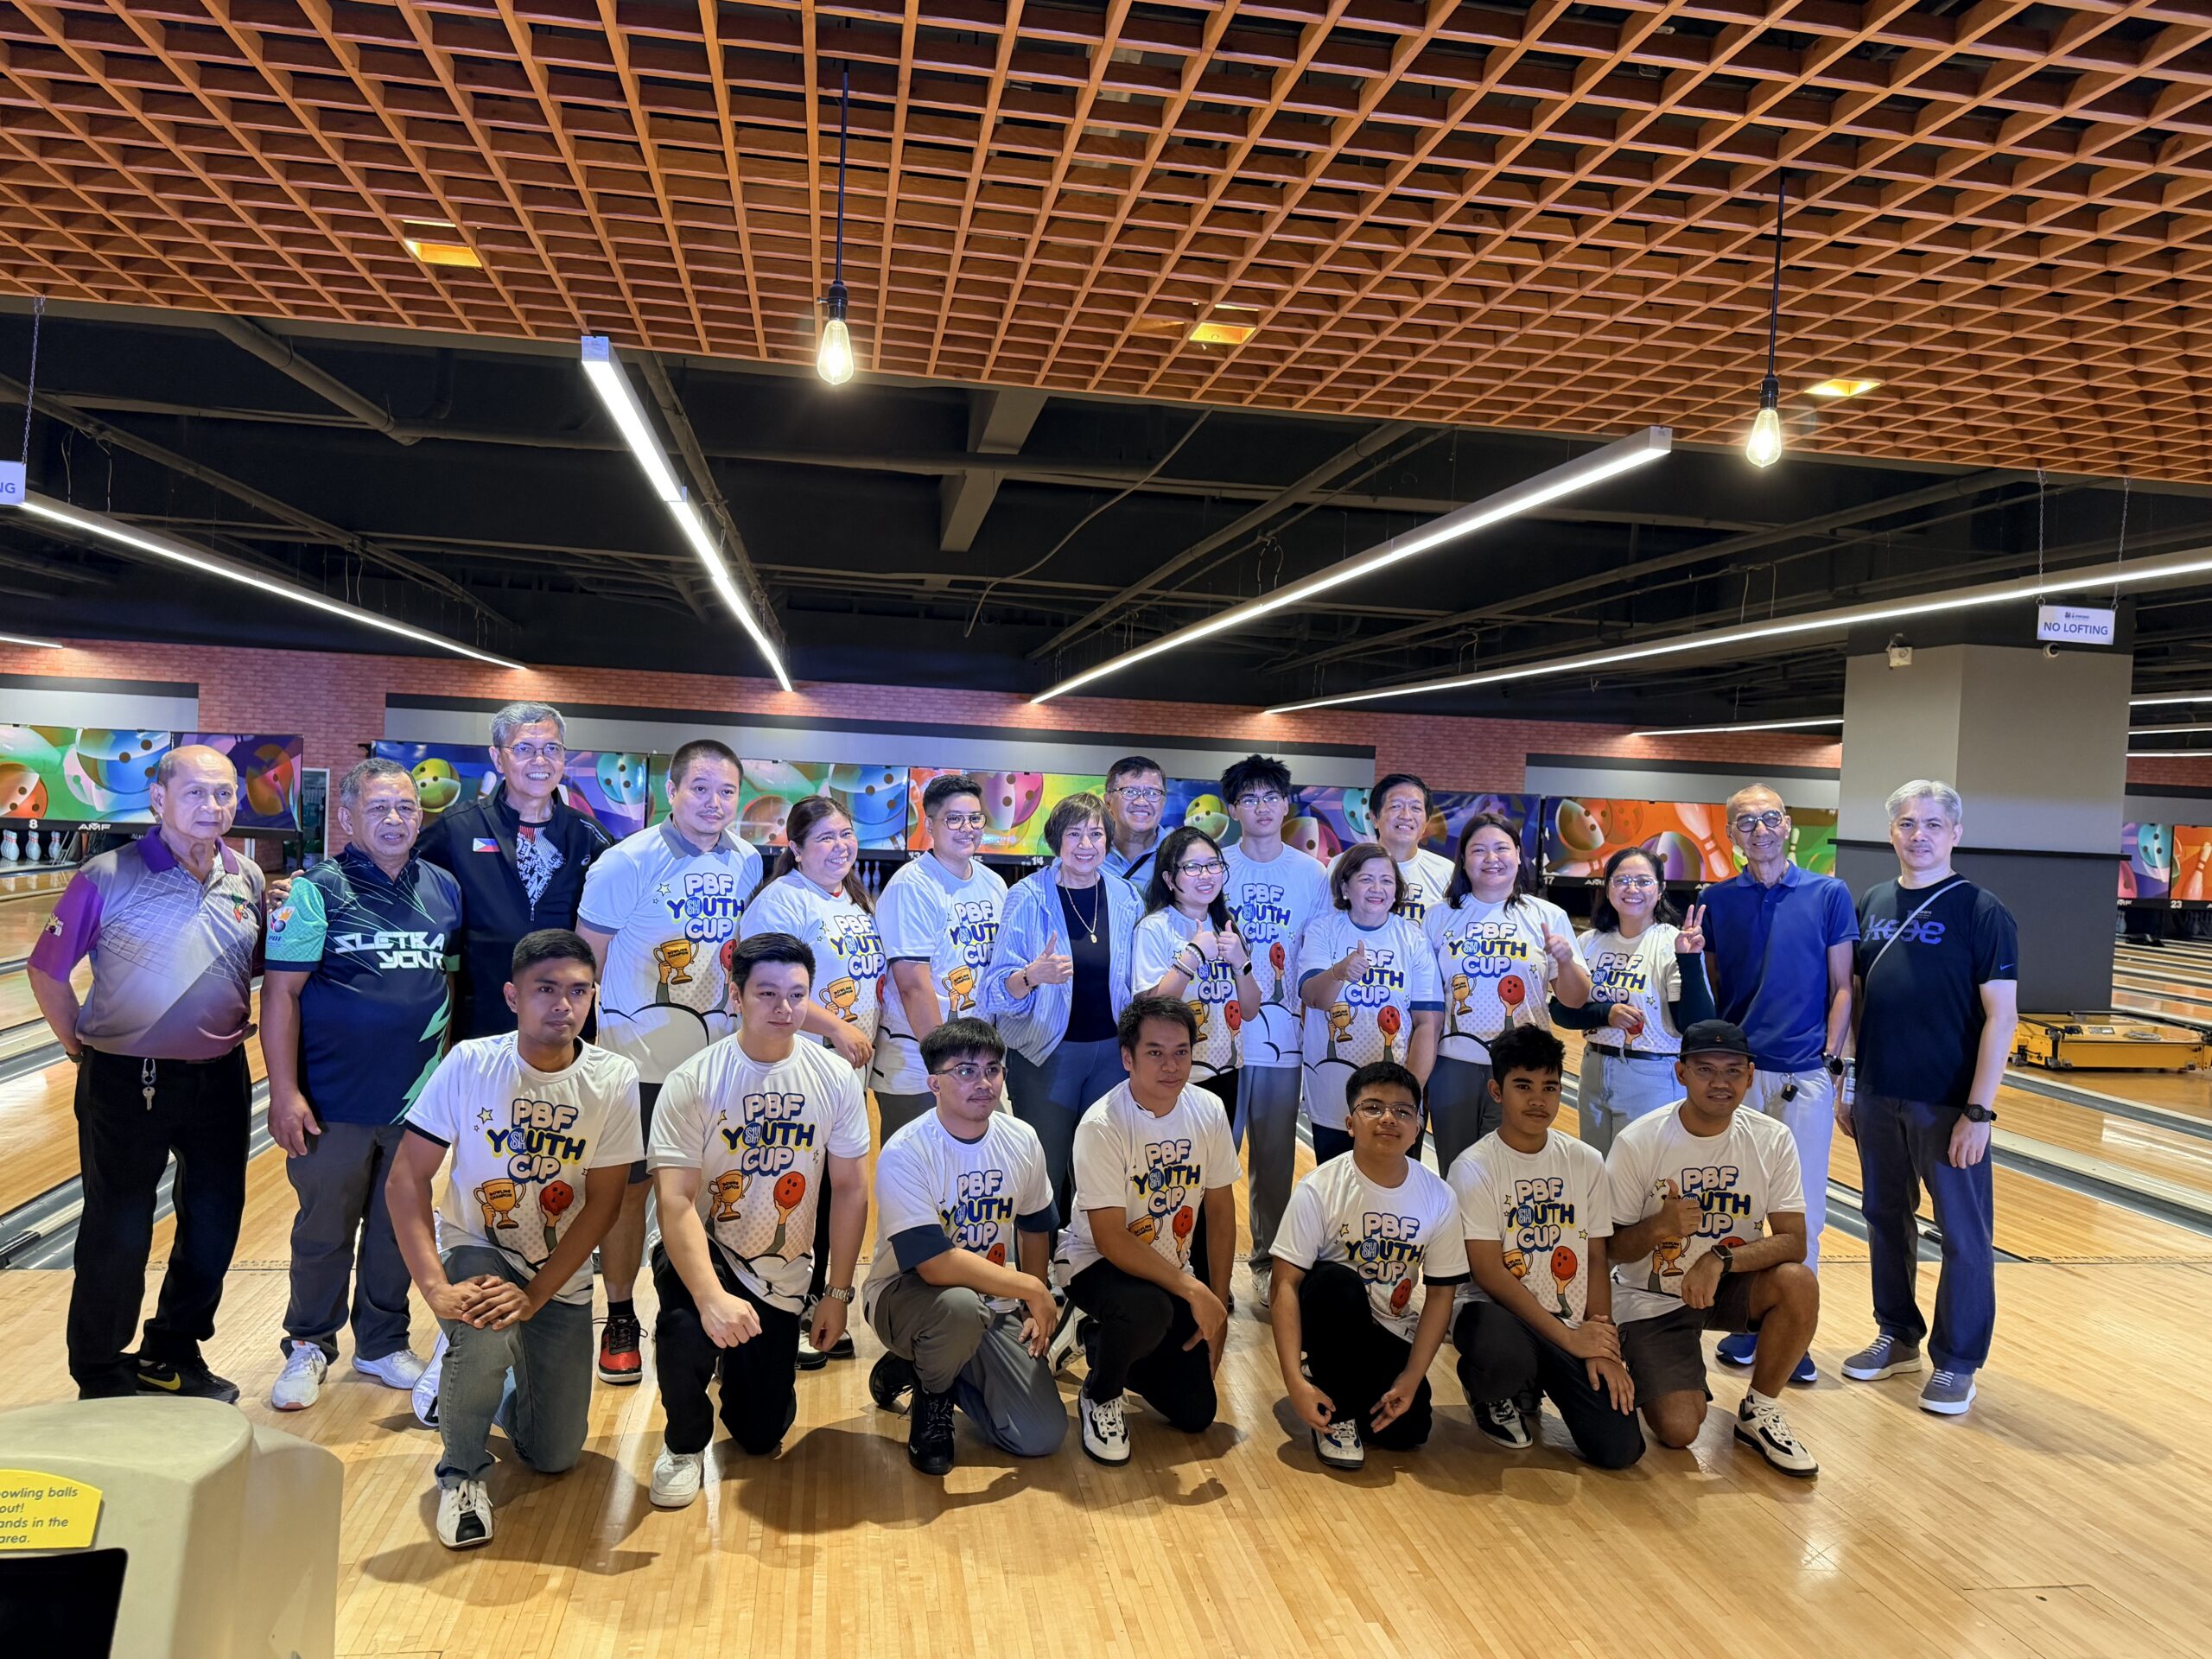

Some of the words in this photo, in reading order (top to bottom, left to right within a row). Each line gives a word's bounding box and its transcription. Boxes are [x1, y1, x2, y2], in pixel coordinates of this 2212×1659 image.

[2044, 622, 2061, 632] NO
[2063, 623, 2108, 635] LOFTING
[29, 819, 38, 829] 8
[1032, 856, 1044, 865] 14
[684, 873, 734, 897] PBF
[1543, 876, 1554, 885] 17
[1242, 883, 1284, 904] PBF
[2171, 900, 2183, 909] 23
[667, 897, 744, 920] YOUTH
[955, 900, 993, 925] PBF
[1229, 904, 1291, 925] YOUTH
[685, 917, 734, 943] CUP
[834, 915, 874, 935] PBF
[1243, 922, 1279, 944] CUP
[1465, 922, 1517, 939] PBF
[830, 935, 882, 955] YOUT
[1449, 940, 1527, 957] YOUTH
[377, 950, 445, 970] YOUT
[849, 952, 886, 981] CUP
[1347, 947, 1394, 968] BF
[1462, 956, 1511, 978] CUP
[1597, 952, 1643, 971] PBF
[1362, 969, 1404, 988] UTH
[1591, 969, 1646, 990] OUTH
[1198, 980, 1232, 1003] CUP
[1344, 983, 1390, 1007] CUP
[512, 1098, 579, 1133] PBF
[743, 1092, 804, 1124] PBF
[486, 1127, 586, 1161] YOUTH
[722, 1122, 815, 1150] YOUTH
[741, 1146, 794, 1176] CUP
[1145, 1139, 1191, 1170] PBF
[957, 1170, 1002, 1205] PBF
[1134, 1165, 1200, 1194] YOUTH
[1515, 1177, 1563, 1205] PBF
[1681, 1166, 1738, 1193] PBF
[941, 1198, 1013, 1226] YOUTH
[1681, 1192, 1751, 1215] UTH
[1363, 1212, 1420, 1242] PBF
[1508, 1204, 1574, 1228] YOUTH
[1695, 1212, 1733, 1239] UP
[951, 1221, 998, 1252] CUP
[1517, 1224, 1560, 1253] CUP
[1345, 1239, 1424, 1262] YOUTH
[1357, 1261, 1407, 1286] CUP
[0, 1488, 44, 1500] owling
[48, 1487, 79, 1497] balls
[32, 1517, 43, 1528] in
[48, 1516, 69, 1528] the
